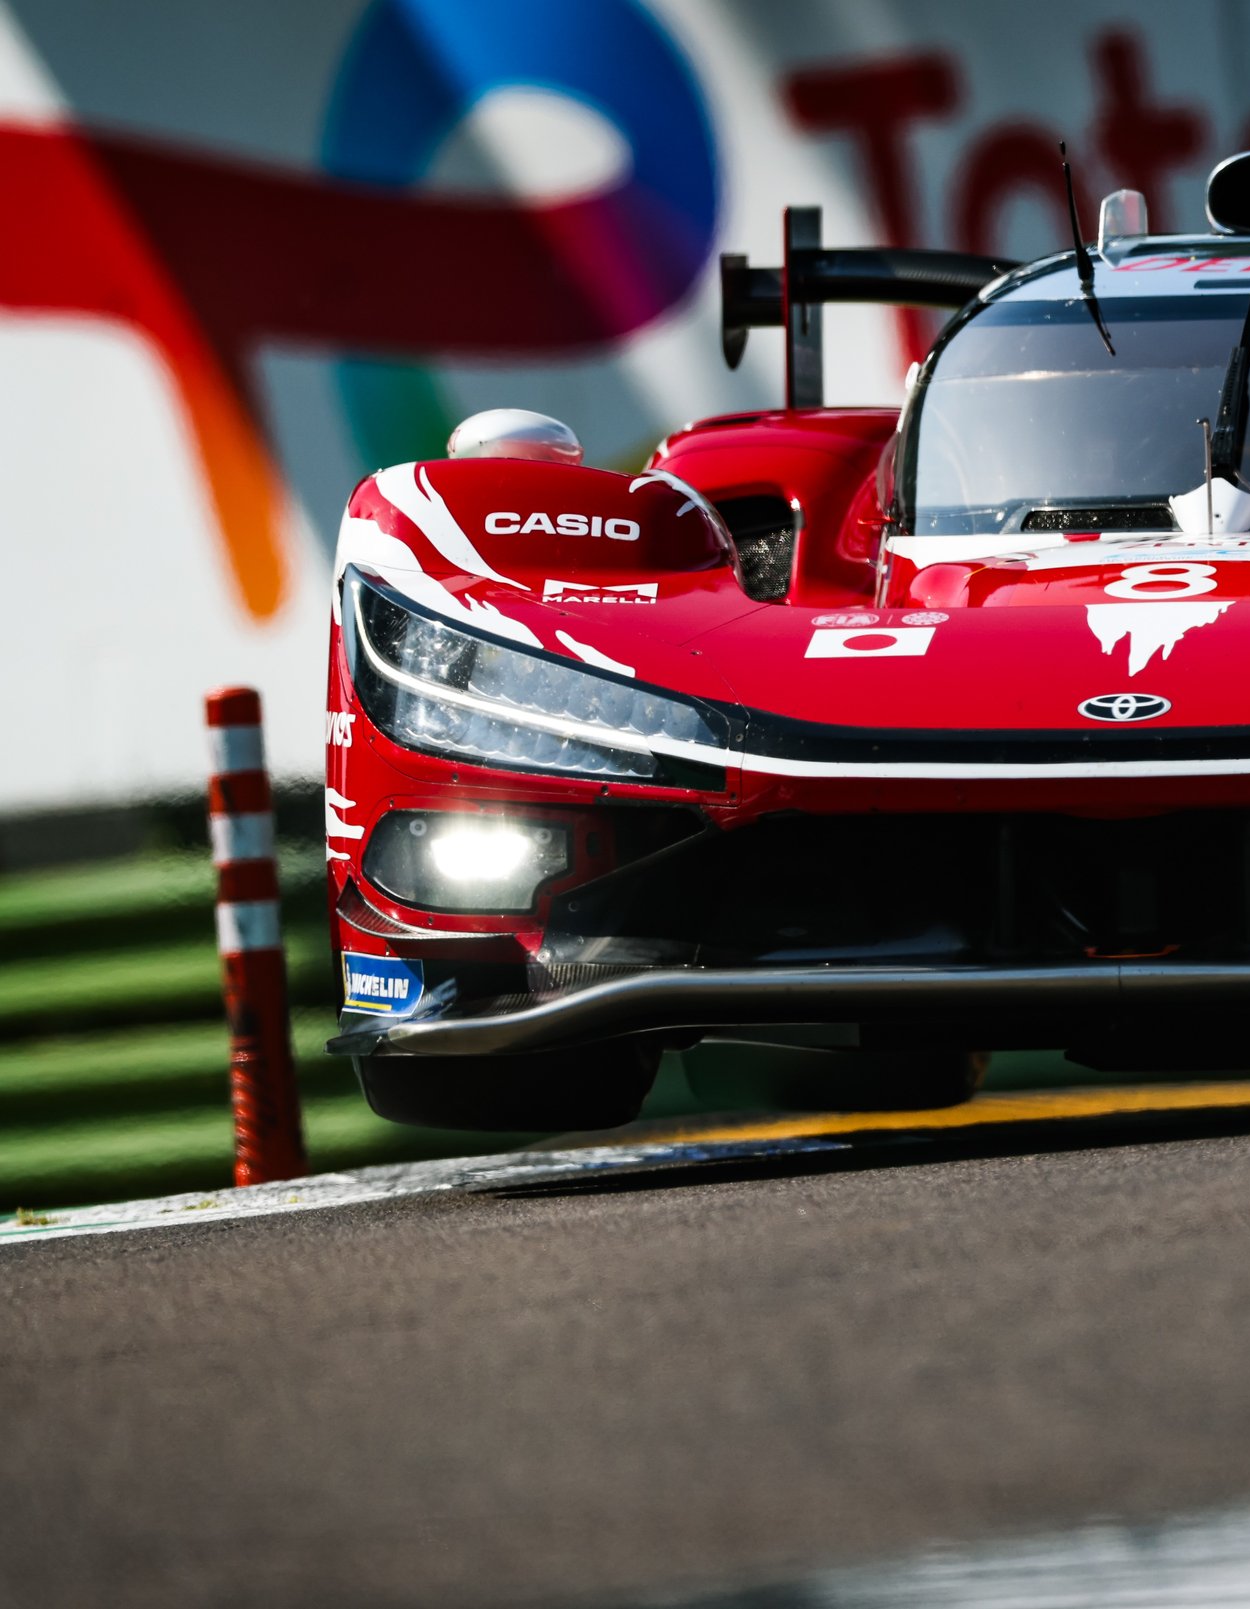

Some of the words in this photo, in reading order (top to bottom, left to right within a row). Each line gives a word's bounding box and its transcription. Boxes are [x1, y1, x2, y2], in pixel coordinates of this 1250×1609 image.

[485, 512, 640, 541] CASIO
[1104, 562, 1218, 600] 8
[542, 596, 656, 604] MARELLI
[817, 614, 871, 626] FIA
[351, 972, 410, 999] MICHELIN
